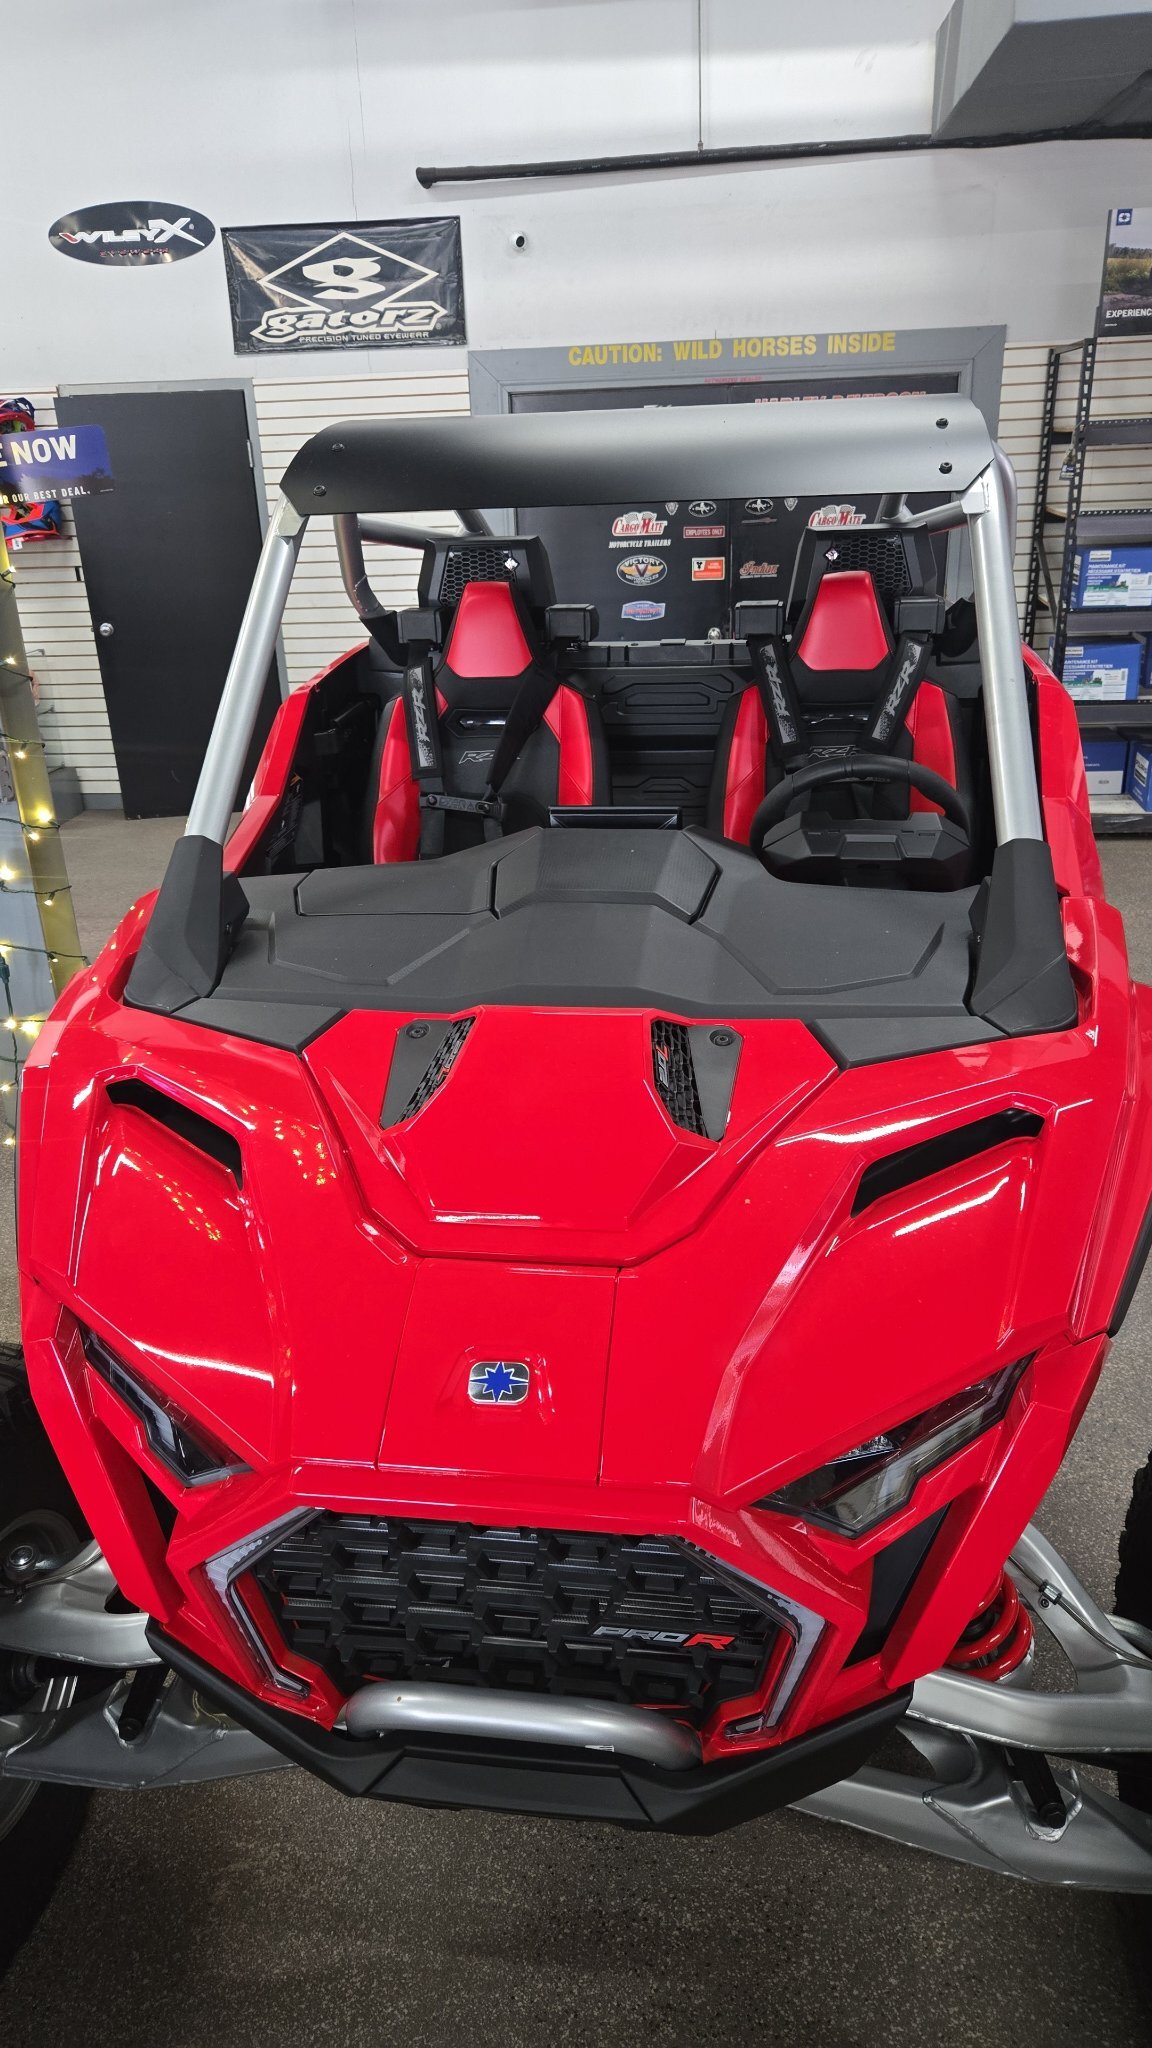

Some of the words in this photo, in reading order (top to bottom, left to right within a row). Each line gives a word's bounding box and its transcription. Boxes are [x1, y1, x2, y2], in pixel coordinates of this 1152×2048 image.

[260, 304, 436, 336] gatorz
[299, 335, 349, 343] PRECISION
[384, 332, 430, 340] EYEWEAR
[568, 343, 663, 366] CAUTION:
[673, 339, 723, 361] WILD
[733, 335, 817, 358] HORSES
[827, 332, 896, 354] INSIDE
[11, 434, 76, 465] NOW
[12, 493, 29, 502] OUR
[34, 489, 57, 500] BEST
[61, 486, 91, 497] DEAL.
[644, 539, 671, 547] TRAILERS
[624, 557, 660, 566] VICTORY
[411, 687, 431, 743] RZR
